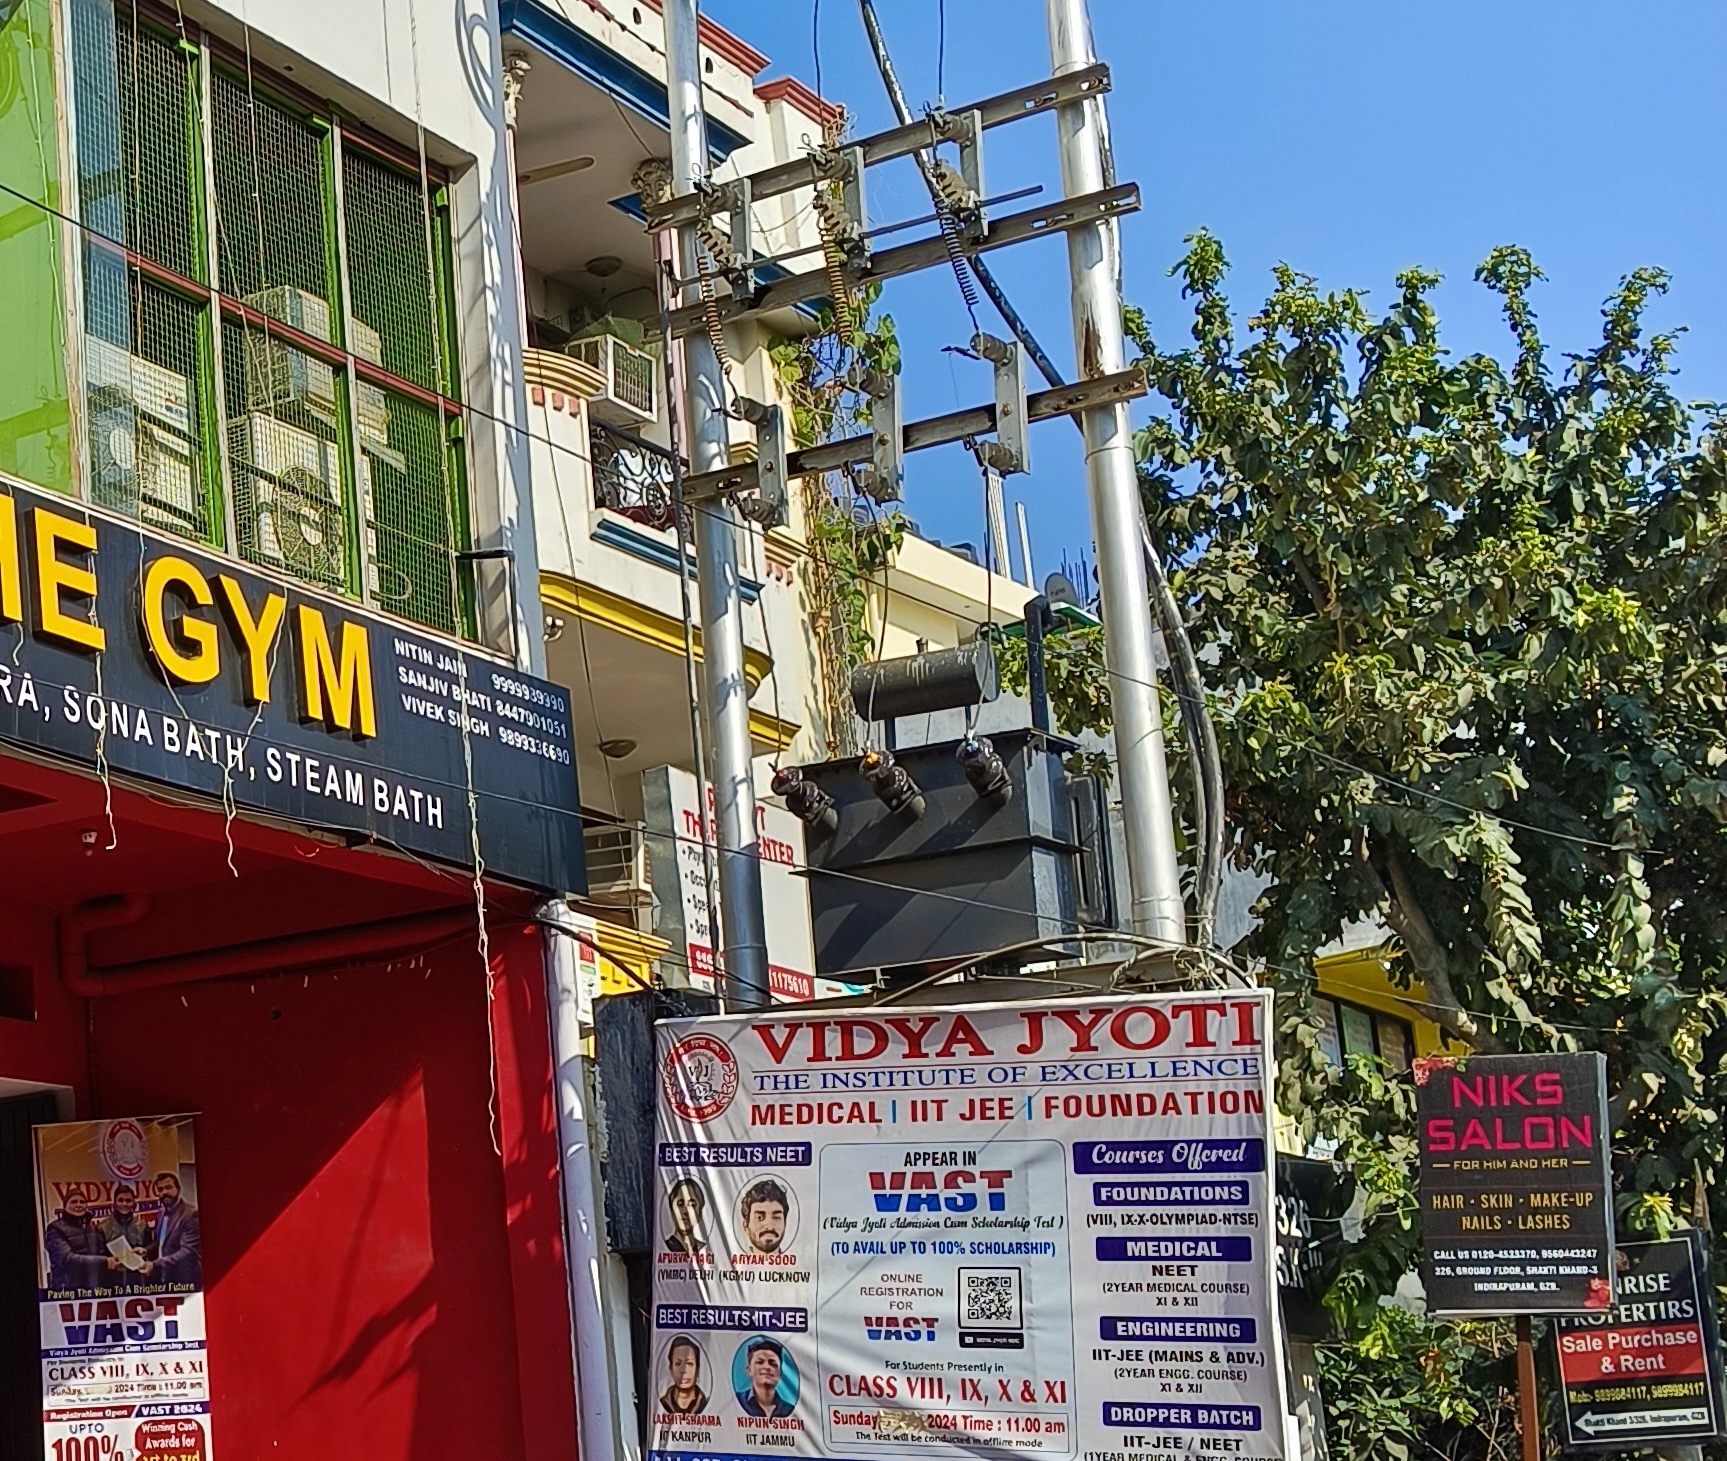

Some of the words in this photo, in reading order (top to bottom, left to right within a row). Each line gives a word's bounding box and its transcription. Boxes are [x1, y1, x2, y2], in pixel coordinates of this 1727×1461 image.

[145, 555, 376, 739] GYM
[394, 638, 433, 665] NITIN
[398, 667, 448, 697] SANJIV
[452, 685, 492, 713] BHATI
[401, 694, 445, 722] VIVEK
[448, 709, 489, 737] SINGH
[62, 686, 154, 746] SONA
[163, 715, 255, 781] BATH,
[265, 748, 365, 807] STEAM
[373, 779, 444, 831] BATH
[751, 1015, 994, 1066] VIDYA
[1018, 1002, 1262, 1055] JYOTI
[754, 1072, 811, 1092] THE
[821, 1068, 976, 1089] INSTITUTE
[987, 1065, 1025, 1083] OF
[1040, 1058, 1259, 1082] EXCELLENCE
[1453, 1073, 1563, 1107] NIKS
[751, 1098, 882, 1126] MEDICAL
[910, 1099, 949, 1122] IIT
[959, 1097, 1015, 1121] JEE
[1044, 1090, 1263, 1120] FOUNDATION
[1428, 1115, 1593, 1150] SALON
[665, 1147, 697, 1163] BEST
[700, 1147, 763, 1163] RESULTS
[766, 1146, 805, 1162] NEET
[904, 1151, 958, 1167] APPEAR
[963, 1151, 977, 1166] IN
[1092, 1143, 1164, 1164] Courses
[1172, 1142, 1246, 1170] Offered
[1454, 1160, 1480, 1170] FOR
[1484, 1160, 1507, 1169] HIM
[1510, 1159, 1537, 1169] AND
[1542, 1159, 1568, 1168] HER
[868, 1170, 1013, 1213] VAST
[1100, 1186, 1242, 1201] FOUNDATIONS
[1433, 1194, 1464, 1209] HAIR
[1481, 1194, 1513, 1208] SKIN
[1530, 1193, 1593, 1207] MAKE-UP
[1462, 1216, 1501, 1230] NAILS
[1518, 1215, 1570, 1230] LASHES
[831, 1242, 849, 1256] (TO
[853, 1241, 887, 1255] AVAIL
[890, 1241, 906, 1254] UP
[912, 1241, 927, 1254] TO
[931, 1241, 965, 1254] 100%
[970, 1241, 1056, 1257] SCHOLARSHIP)
[1127, 1241, 1222, 1257] MEDICAL
[881, 1274, 923, 1283] ONLINE
[1152, 1265, 1198, 1276] NEET
[860, 1287, 944, 1297] REGISTRATION
[889, 1301, 913, 1310] FOR
[59, 1297, 185, 1345] VAST
[659, 1309, 688, 1324] BEST
[691, 1310, 751, 1326] RESULTS
[864, 1316, 939, 1341] VAST
[1116, 1321, 1241, 1337] ENGINEERING
[1563, 1336, 1603, 1352] Sale
[1608, 1331, 1697, 1350] Purchase
[1092, 1349, 1144, 1361] IIT-JEE
[1149, 1350, 1203, 1364] (MAINS
[1209, 1351, 1220, 1363] &
[1226, 1352, 1265, 1366] ADV.)
[1601, 1356, 1615, 1373] &
[1620, 1354, 1665, 1371] Rent
[829, 1374, 897, 1398] CLASS
[907, 1377, 951, 1405] VIII,
[961, 1379, 989, 1406] IX,
[998, 1380, 1012, 1402] X
[1021, 1380, 1036, 1403] &
[1045, 1380, 1066, 1403] XI
[1110, 1407, 1192, 1424] DROPPER
[1198, 1410, 1254, 1426] BATCH
[69, 1423, 104, 1434] UPTO
[145, 1437, 179, 1449] Awards
[182, 1435, 195, 1447] for
